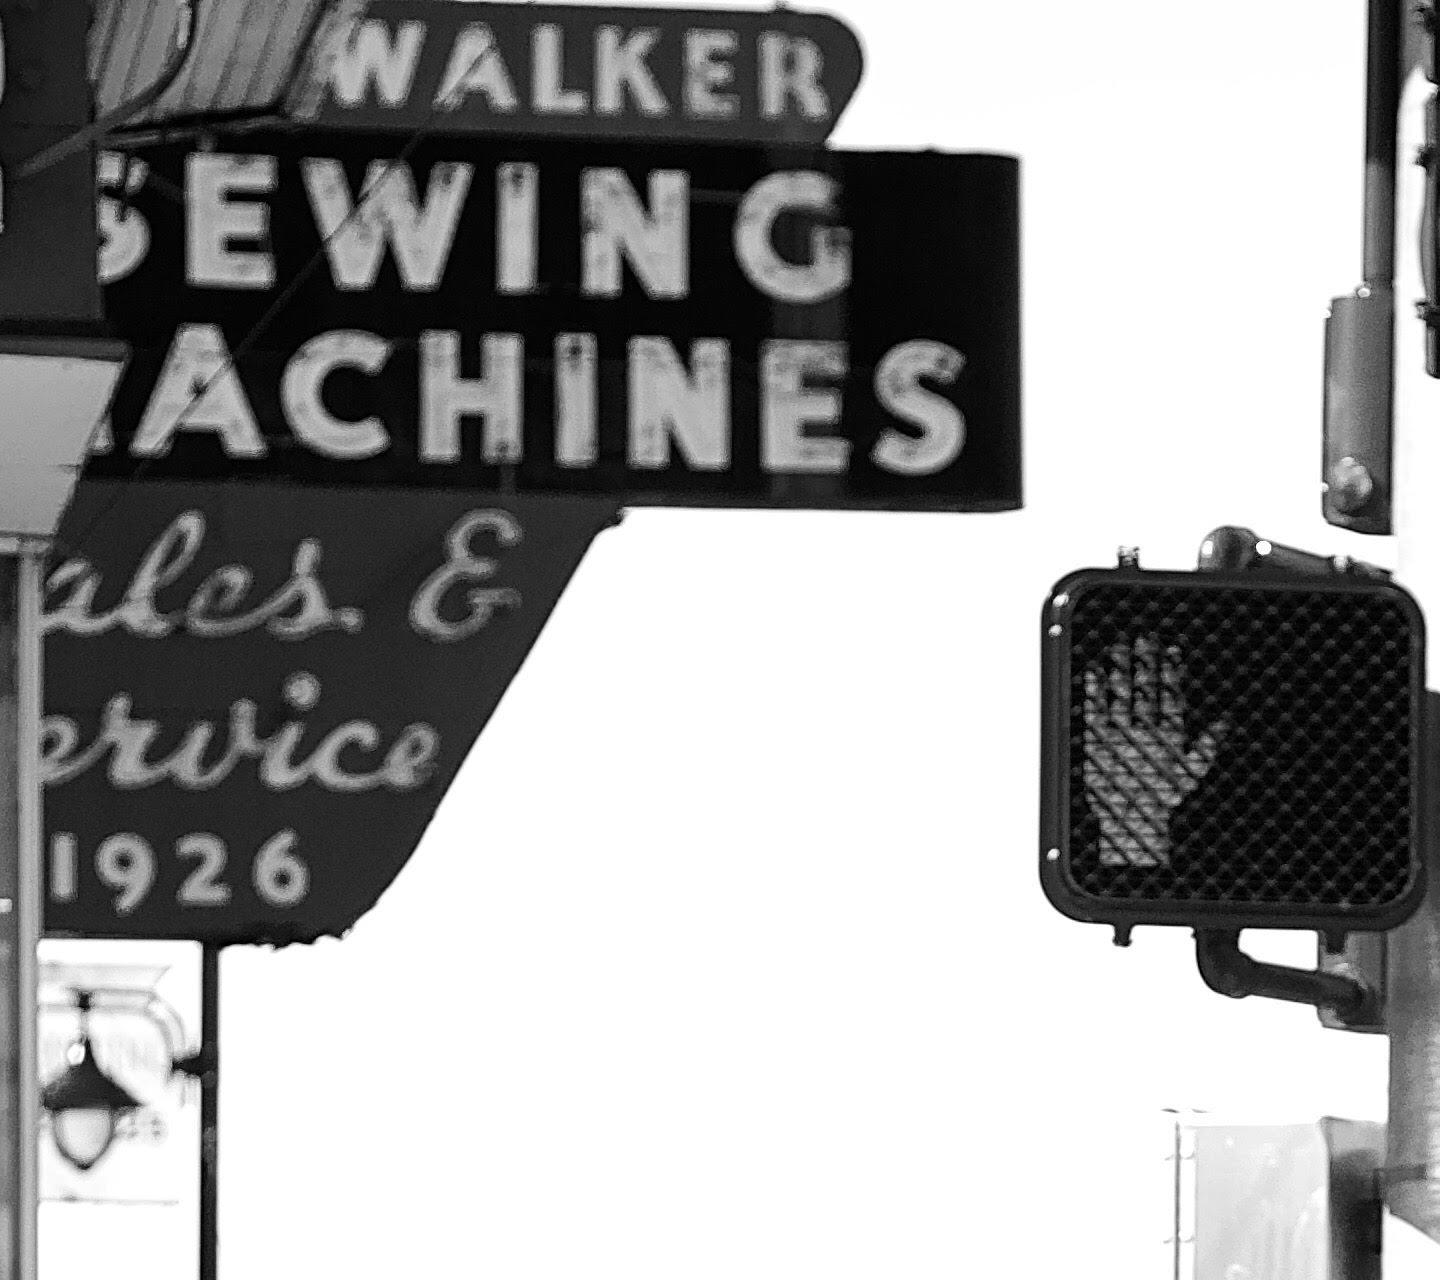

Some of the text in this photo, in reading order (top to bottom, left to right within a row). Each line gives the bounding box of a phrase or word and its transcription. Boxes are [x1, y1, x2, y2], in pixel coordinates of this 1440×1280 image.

[328, 18, 828, 120] WALKER
[90, 322, 967, 475] ACHINES
[408, 506, 522, 645] &
[40, 670, 442, 790] ervice
[52, 830, 310, 912] 1926
